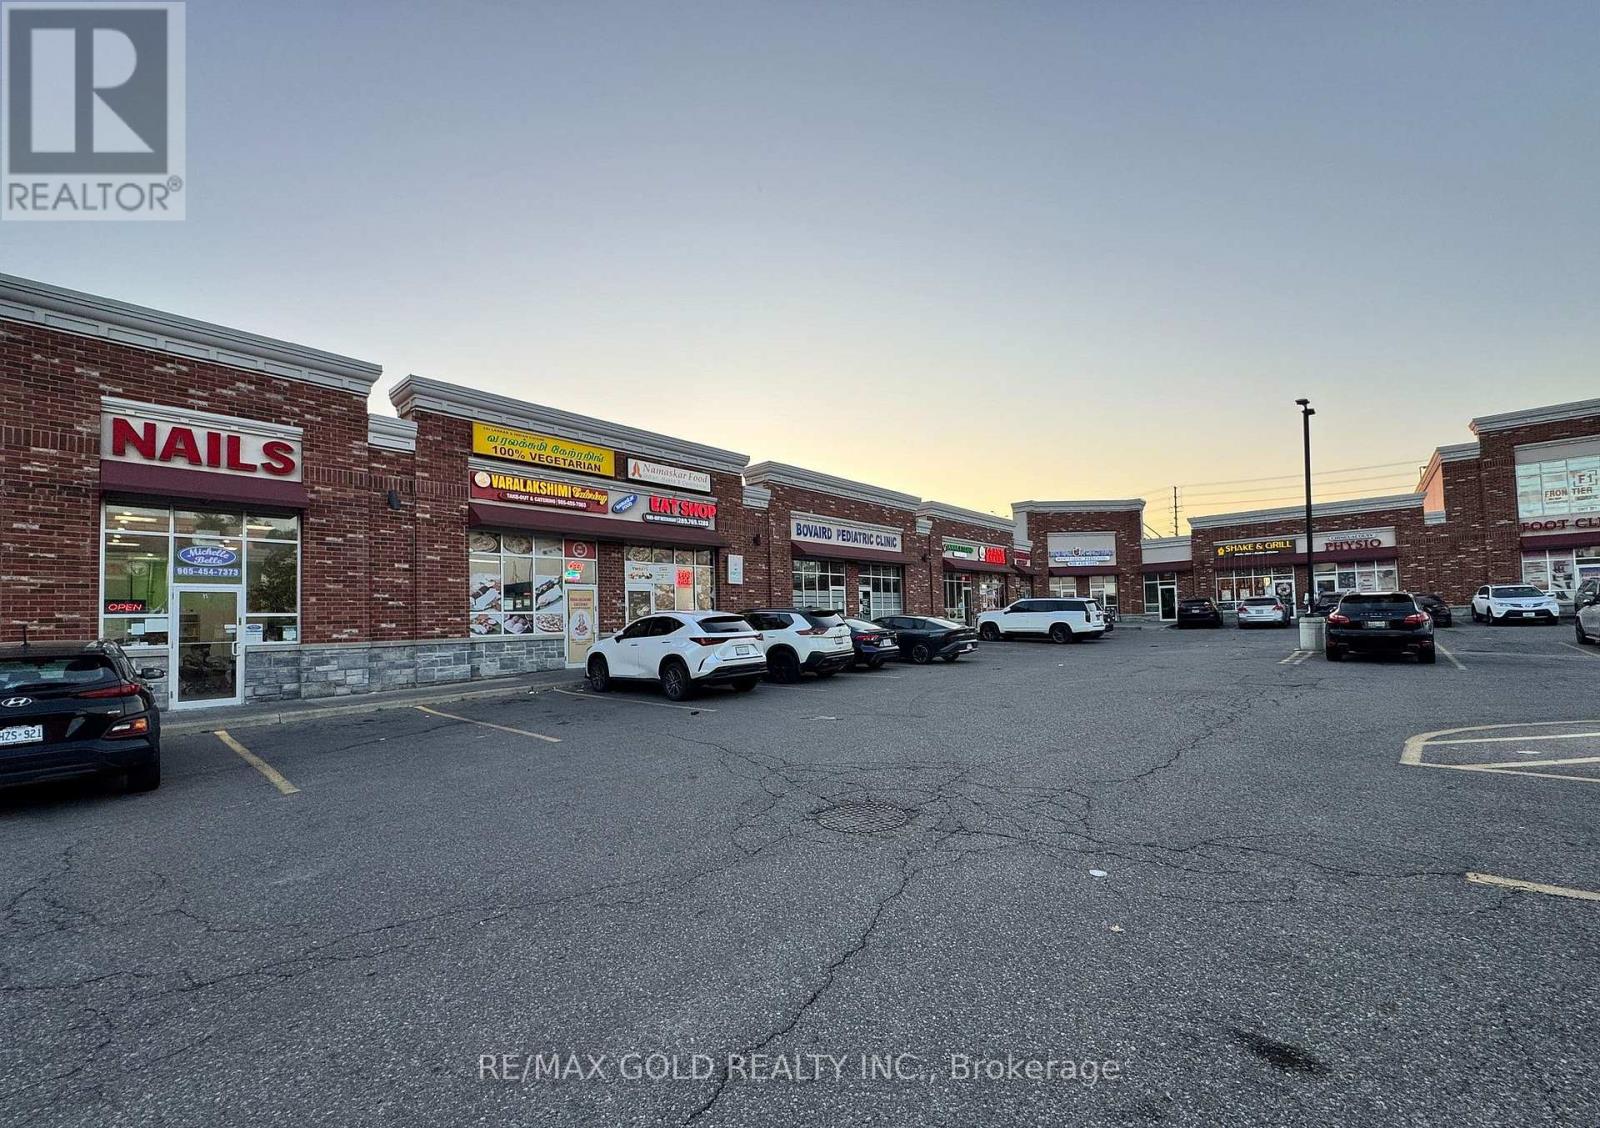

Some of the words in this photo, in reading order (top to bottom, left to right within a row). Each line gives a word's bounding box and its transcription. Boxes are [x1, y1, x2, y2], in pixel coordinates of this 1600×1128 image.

[112, 416, 297, 476] NAILS
[492, 445, 525, 460] 100%
[529, 452, 601, 472] VEGETARIAN
[643, 463, 687, 480] Namaskar
[688, 473, 708, 484] Food
[491, 474, 572, 498] VARALAKSHIMI
[1572, 486, 1593, 495] TIER
[649, 494, 679, 515] EAT
[680, 499, 717, 520] SHOP
[1519, 519, 1569, 532] FOOT
[796, 522, 832, 540] BOVAIRD
[836, 527, 874, 545] PEDIATRIC
[875, 532, 897, 549] CLINIC
[1225, 543, 1254, 553] SHAKE
[1255, 542, 1263, 550] &
[1265, 540, 1292, 550] GRILL
[1325, 538, 1381, 552] PHYSIO
[187, 546, 230, 559] Michelle
[193, 556, 223, 565] Belle
[177, 567, 239, 576] 905-454-7373
[108, 603, 142, 612] OPEN
